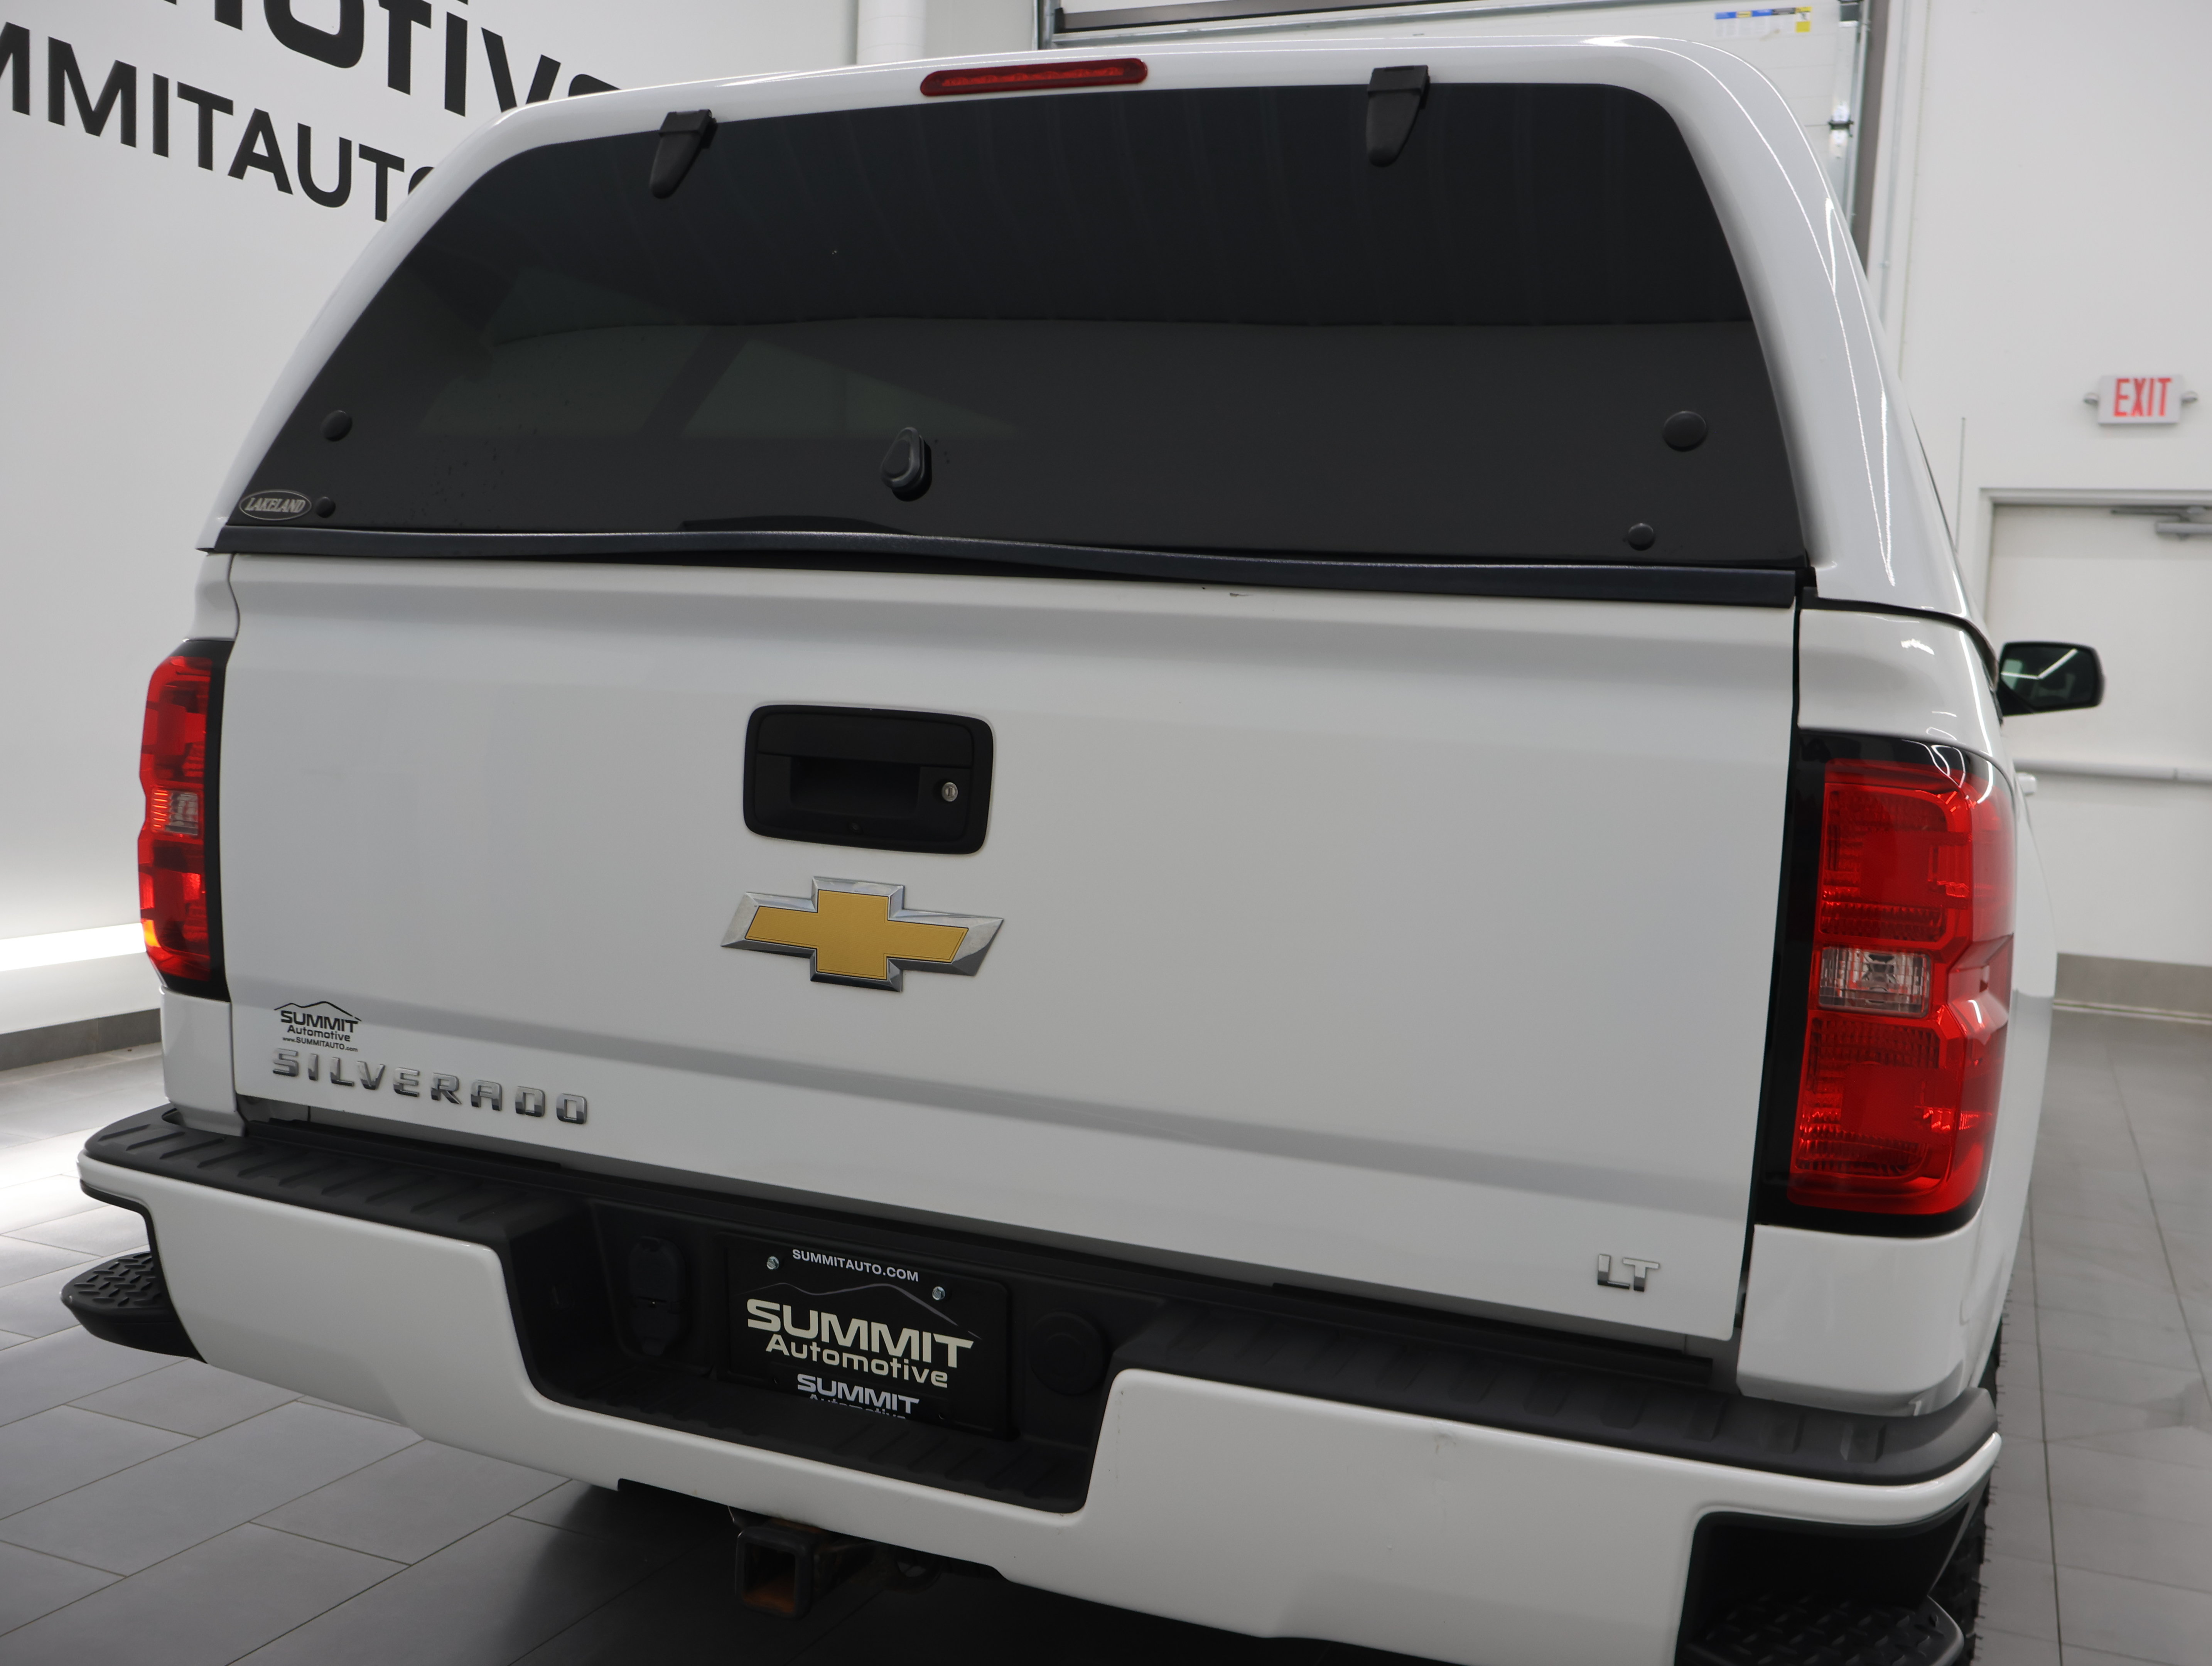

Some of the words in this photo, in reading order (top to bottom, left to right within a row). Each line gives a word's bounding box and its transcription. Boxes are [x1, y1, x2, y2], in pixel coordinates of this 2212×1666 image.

[0, 22, 435, 223] MITAUT
[2114, 378, 2172, 417] EXIT
[245, 497, 306, 513] LAKELAND
[281, 1010, 358, 1033] SUMMIT
[287, 1025, 351, 1042] Automotive
[282, 1037, 358, 1052] www.SUMMITAUTO.com
[272, 1048, 587, 1125] SILVERADO
[793, 1249, 919, 1282] SUMMITAUTO.COM
[1598, 1254, 1660, 1292] LT
[747, 1298, 974, 1368] SUMMIT
[766, 1334, 948, 1388] Automotive
[797, 1373, 920, 1414] SUMMIT
